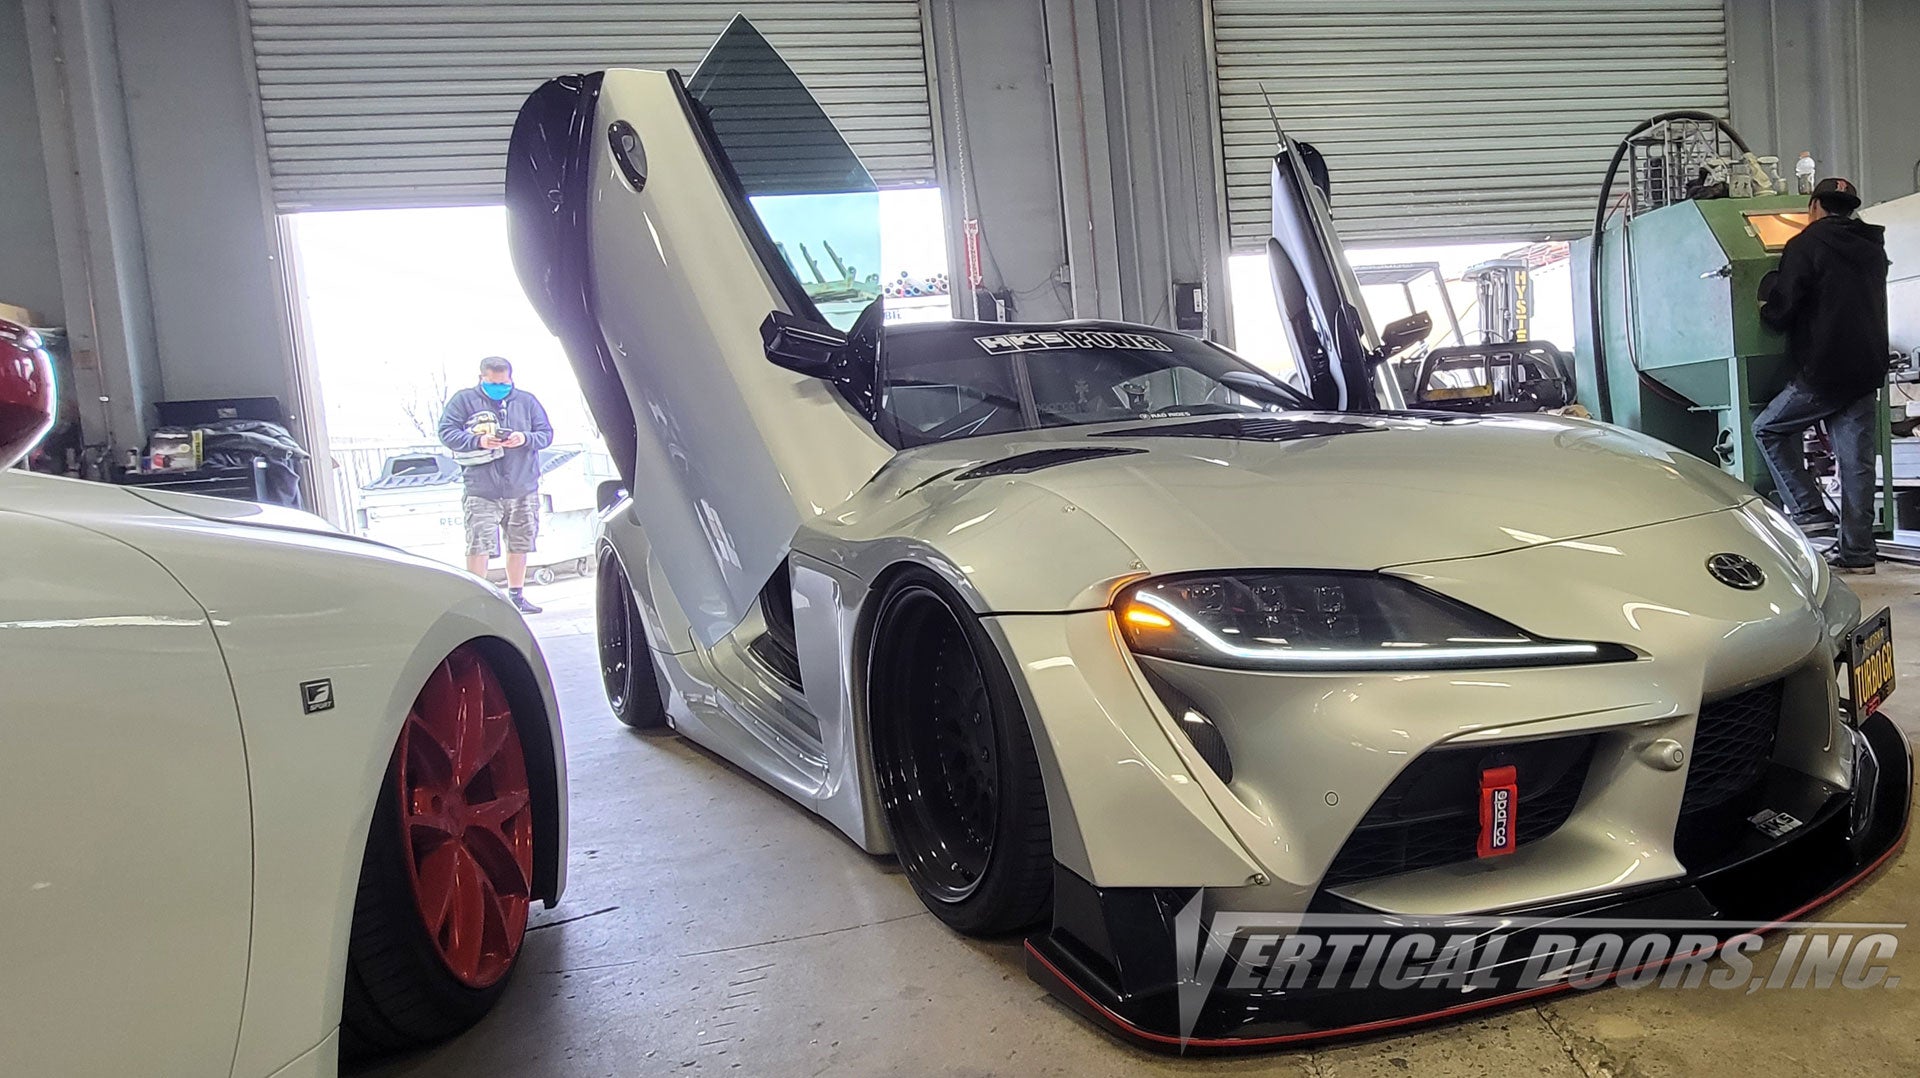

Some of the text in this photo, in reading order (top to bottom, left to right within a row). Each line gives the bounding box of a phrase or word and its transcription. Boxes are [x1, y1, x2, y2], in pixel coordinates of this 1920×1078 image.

[980, 331, 1173, 352] HKS POWER
[1855, 650, 1882, 708] TURBO
[1881, 641, 1893, 682] GR
[1758, 812, 1797, 835] HKS
